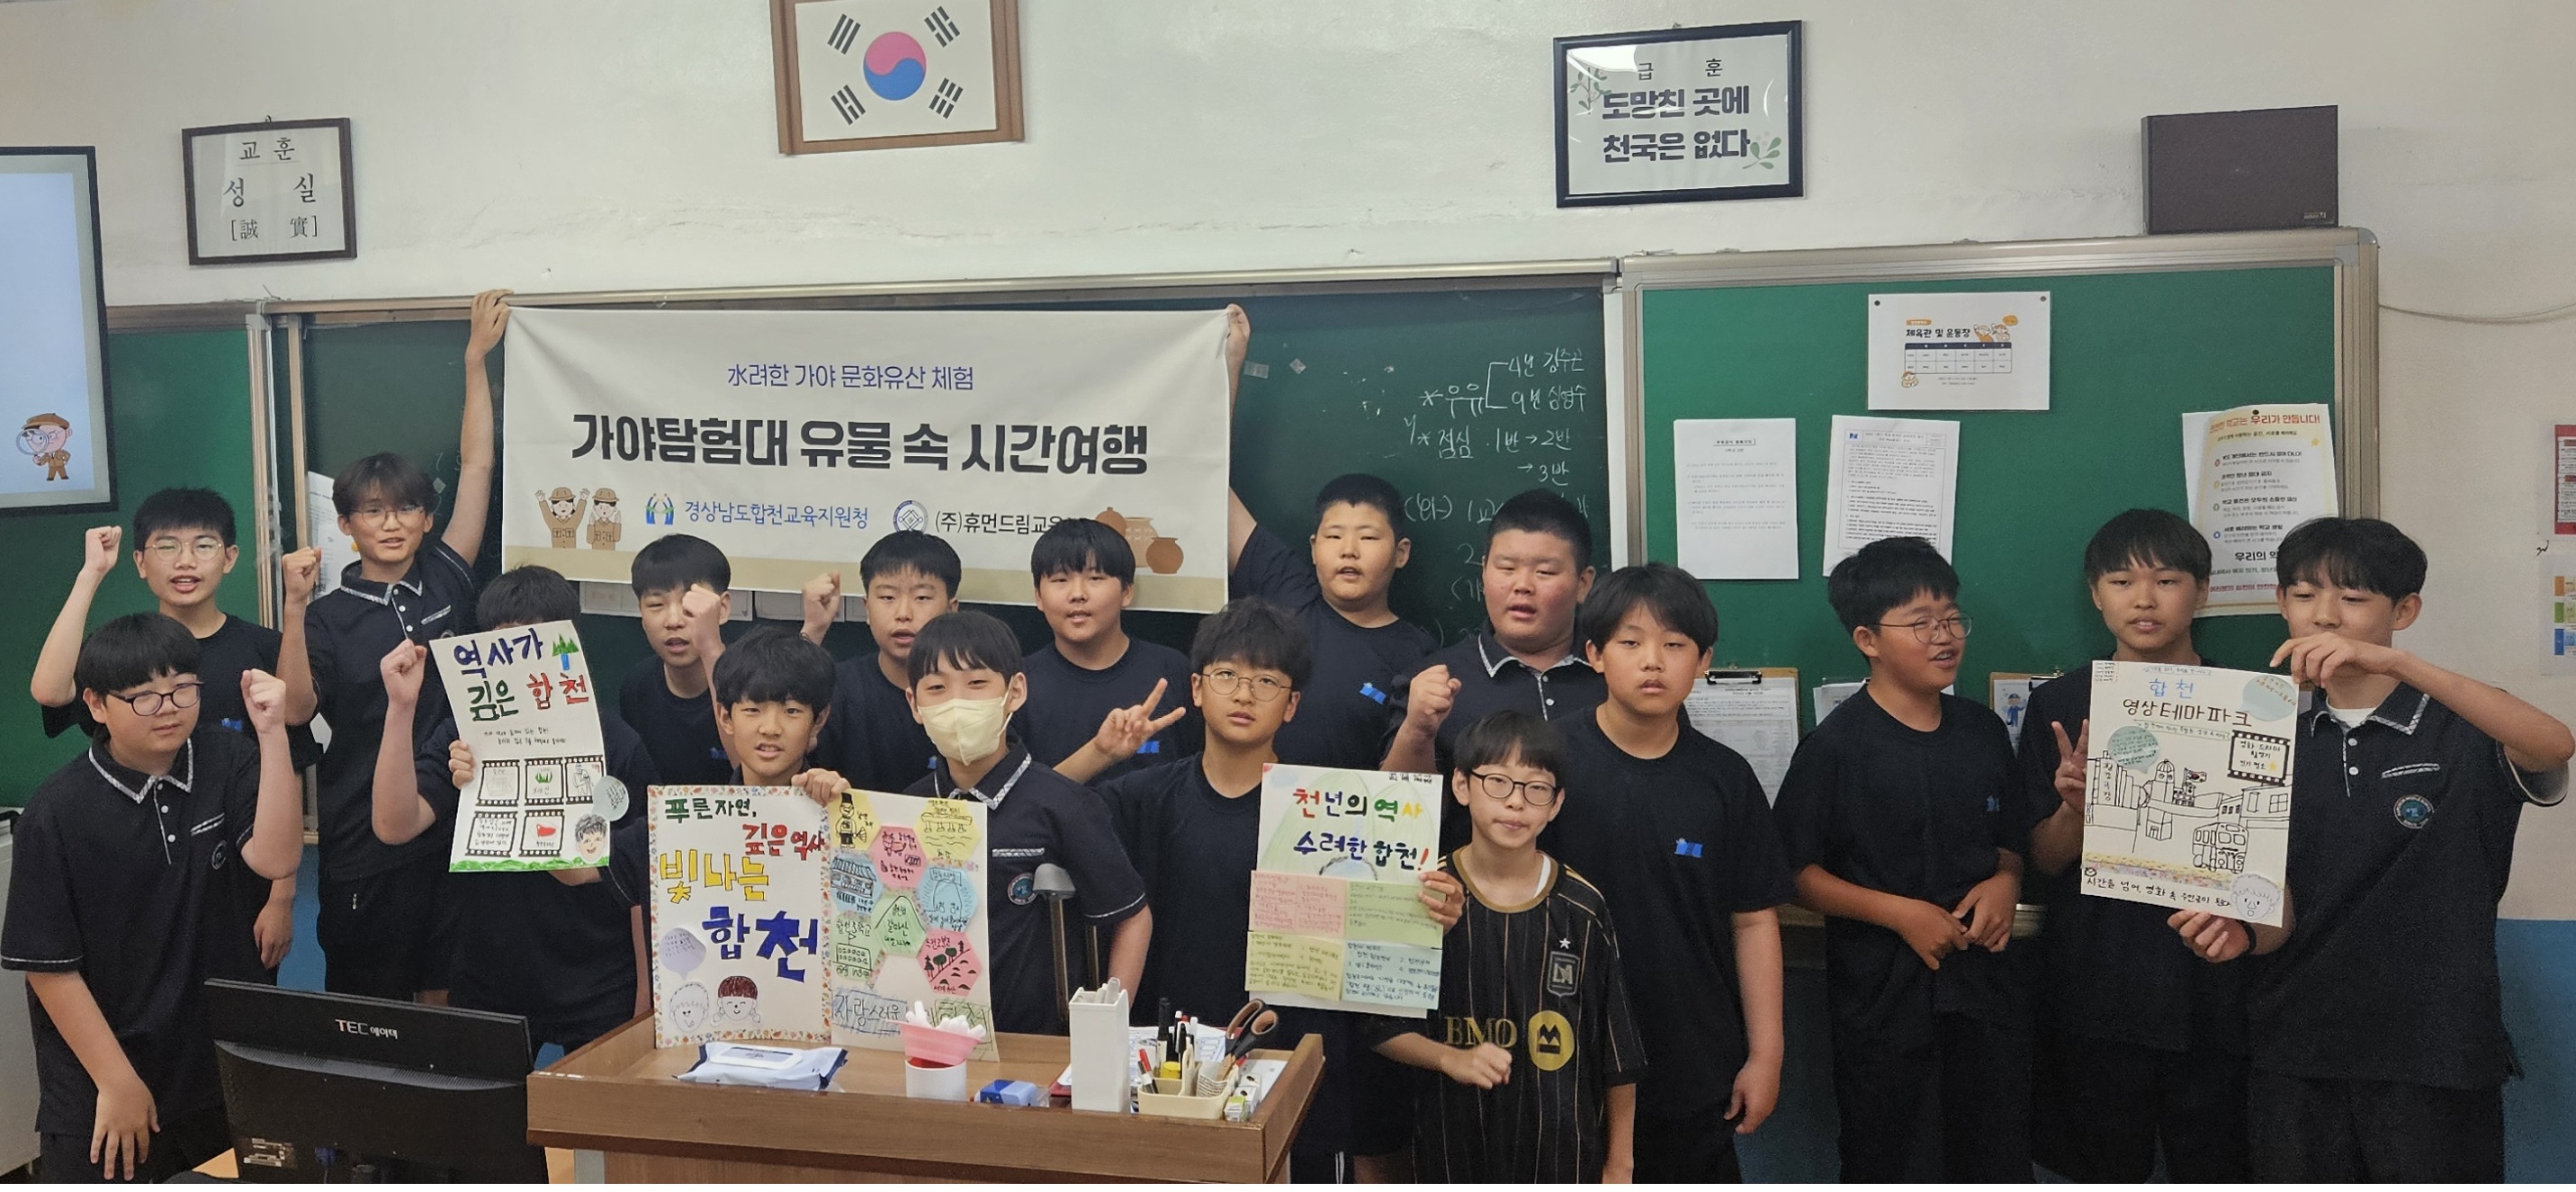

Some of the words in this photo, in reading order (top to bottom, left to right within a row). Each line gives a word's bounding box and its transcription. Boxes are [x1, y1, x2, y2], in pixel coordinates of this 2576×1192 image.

[1602, 88, 1685, 120] 도망친
[1692, 85, 1750, 117] 곳에
[1603, 132, 1685, 163] 천국은
[1693, 129, 1751, 160] 없다
[223, 177, 245, 207] 성
[293, 173, 316, 202] 실
[1907, 328, 1931, 338] 체육관
[727, 363, 789, 387] 水려한
[794, 364, 836, 388] 가야
[841, 364, 926, 390] 문화유산
[931, 365, 974, 390] 체험
[2250, 415, 2280, 425] 우리가
[572, 414, 788, 467] 가야탐험대
[800, 420, 891, 469] 유물
[903, 423, 948, 471] 속
[961, 424, 1147, 475] 시간여행
[685, 500, 868, 530] 경상남도합천교육지원청
[2235, 551, 2266, 561] 우리의
[453, 628, 543, 678] 역사가
[526, 672, 589, 710] 합천
[2149, 678, 2194, 699] 합천
[665, 797, 713, 823] 푸른
[1293, 788, 1368, 819] 천년의
[1374, 799, 1423, 822] 역사
[742, 822, 787, 856] 깊은
[790, 830, 825, 862] 역사
[1293, 830, 1368, 861] 수려한
[1373, 840, 1430, 872] 합천!
[660, 848, 769, 904] 빛나는
[701, 906, 818, 983] 합천
[335, 1018, 368, 1035] TEC
[1444, 1016, 1517, 1048] BMO
